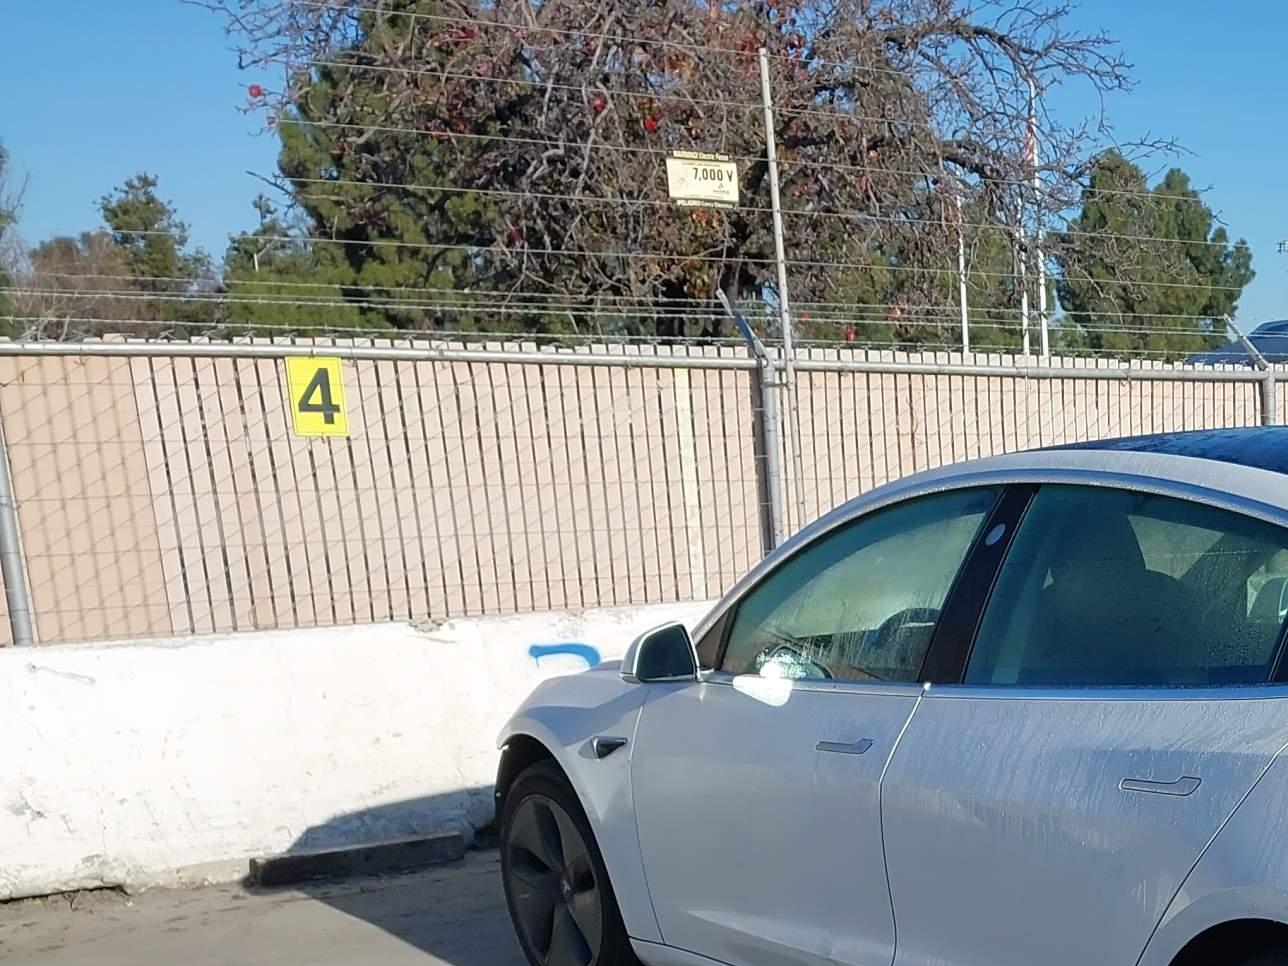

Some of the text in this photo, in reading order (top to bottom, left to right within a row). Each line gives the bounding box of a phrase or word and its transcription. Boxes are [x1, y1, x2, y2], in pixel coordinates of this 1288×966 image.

[692, 167, 733, 182] 7,000 V
[298, 367, 340, 425] 4
